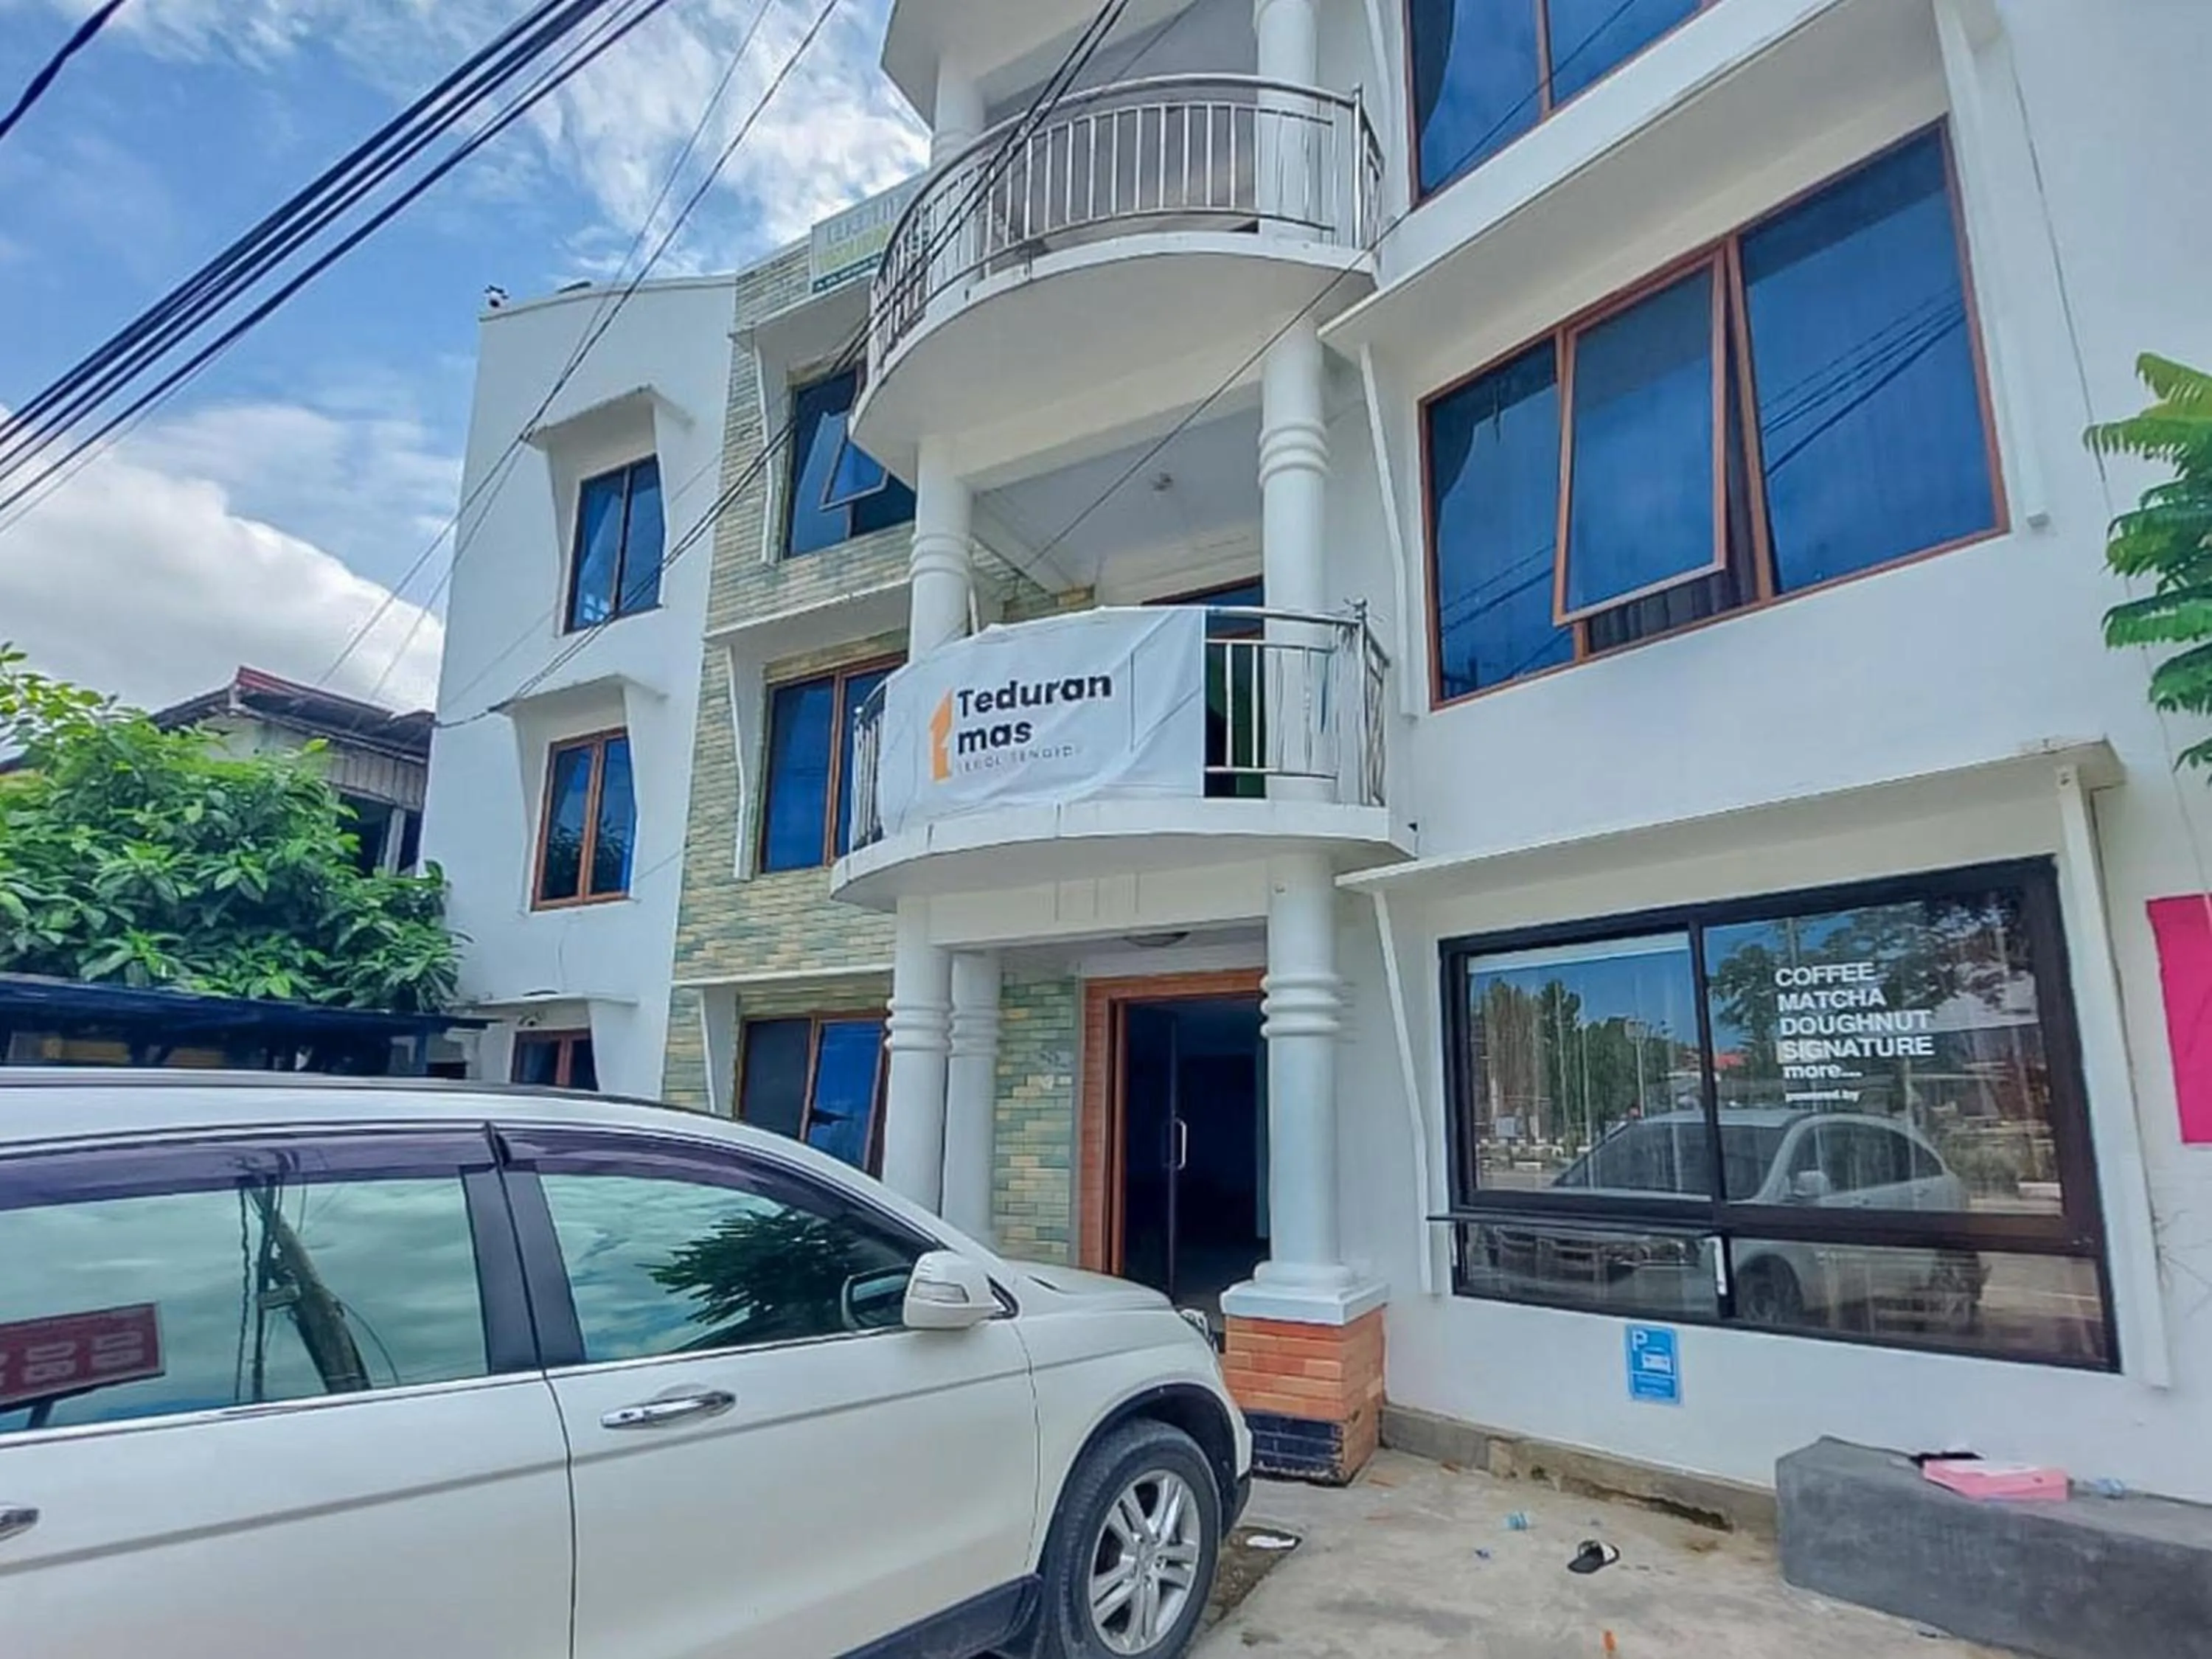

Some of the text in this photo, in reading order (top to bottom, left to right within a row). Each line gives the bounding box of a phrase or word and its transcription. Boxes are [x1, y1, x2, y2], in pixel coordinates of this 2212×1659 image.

[958, 674, 1111, 717] Teduran
[958, 720, 1032, 756] mas
[1775, 962, 1875, 987] COFFEE
[1778, 987, 1886, 1011] MATCHA
[1780, 1010, 1931, 1035] DOUGHNUT
[1783, 1037, 1934, 1059] SIGNATURE
[1632, 1329, 1649, 1352] P
